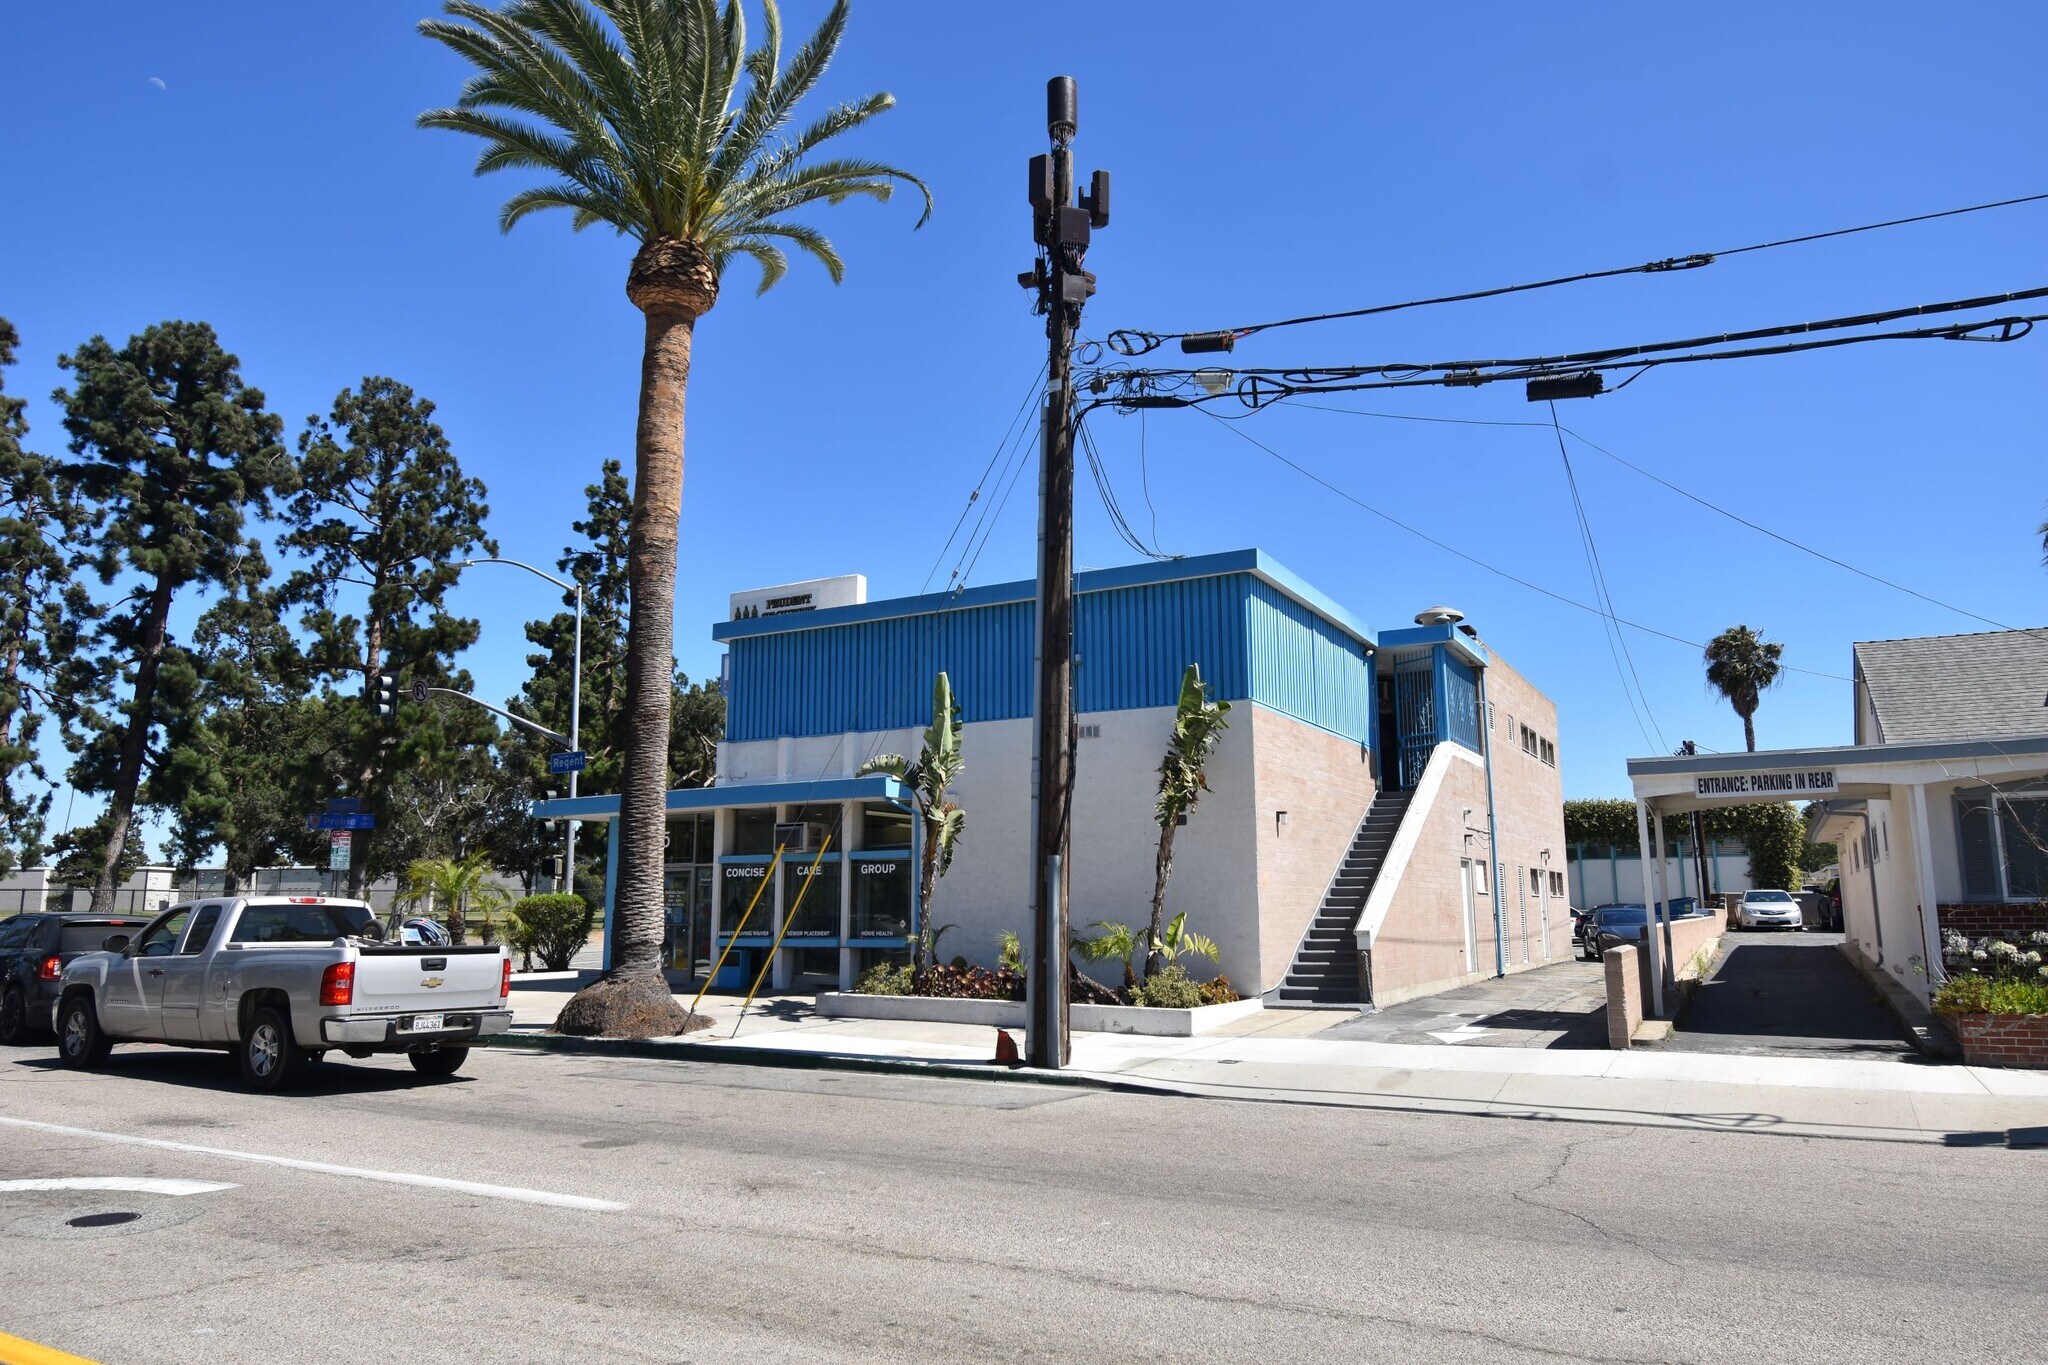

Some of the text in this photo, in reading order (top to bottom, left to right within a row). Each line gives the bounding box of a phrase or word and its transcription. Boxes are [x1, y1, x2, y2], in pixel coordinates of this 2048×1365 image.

[553, 755, 584, 769] Regent
[1698, 771, 1834, 794] ENTRANCE: PARKING IN REAR
[323, 817, 357, 826] Prairie
[726, 867, 765, 877] CONCISE
[861, 864, 896, 874] GROUP
